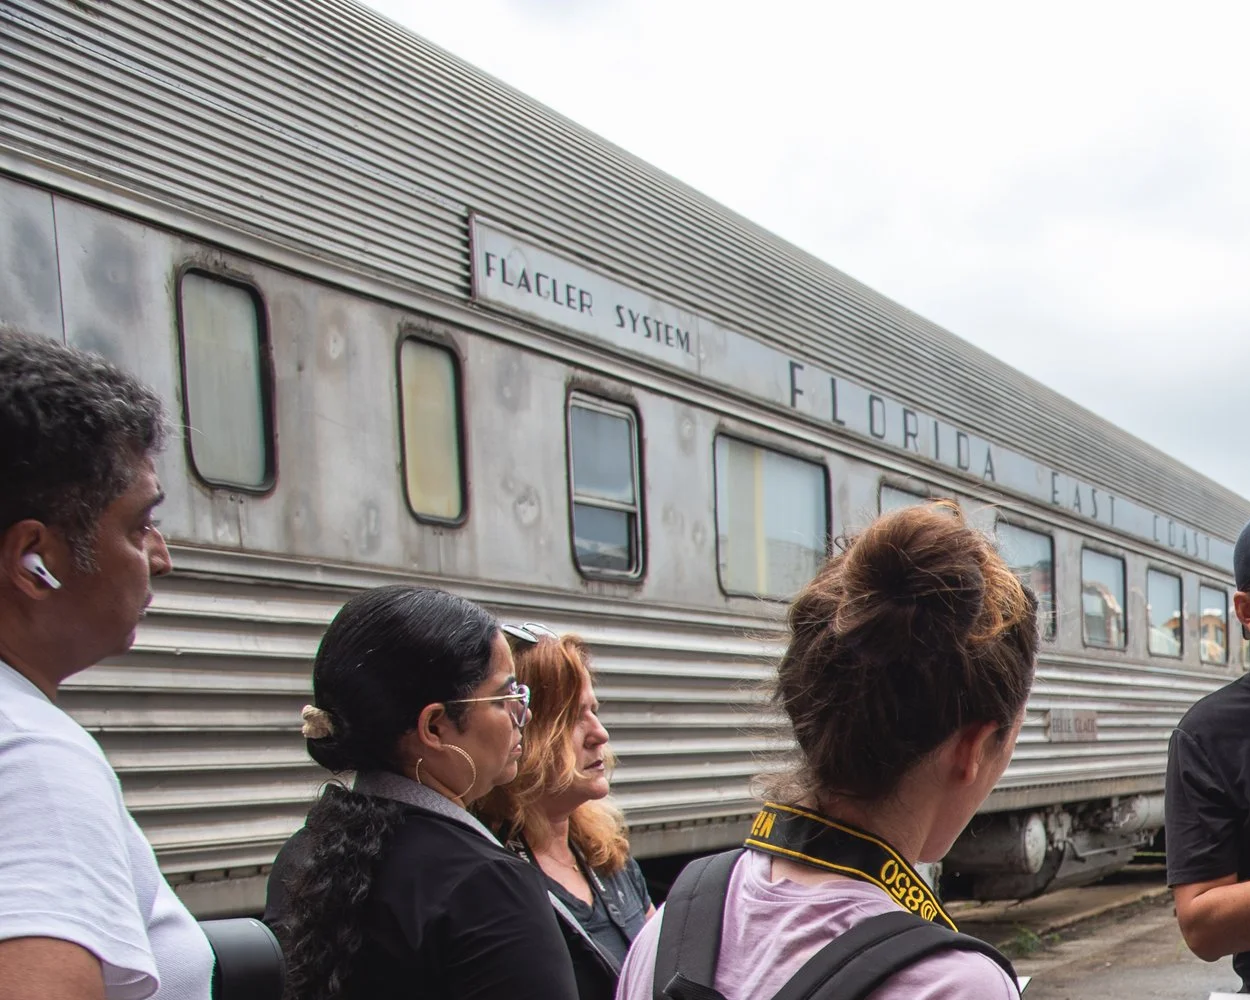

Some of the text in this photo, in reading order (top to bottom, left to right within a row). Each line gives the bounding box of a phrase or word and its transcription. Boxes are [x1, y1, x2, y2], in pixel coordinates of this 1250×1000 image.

[485, 251, 691, 353] FLAGLER SYSTEM
[789, 360, 1210, 560] FLORIDA EAST COAST
[880, 859, 937, 922] D850
